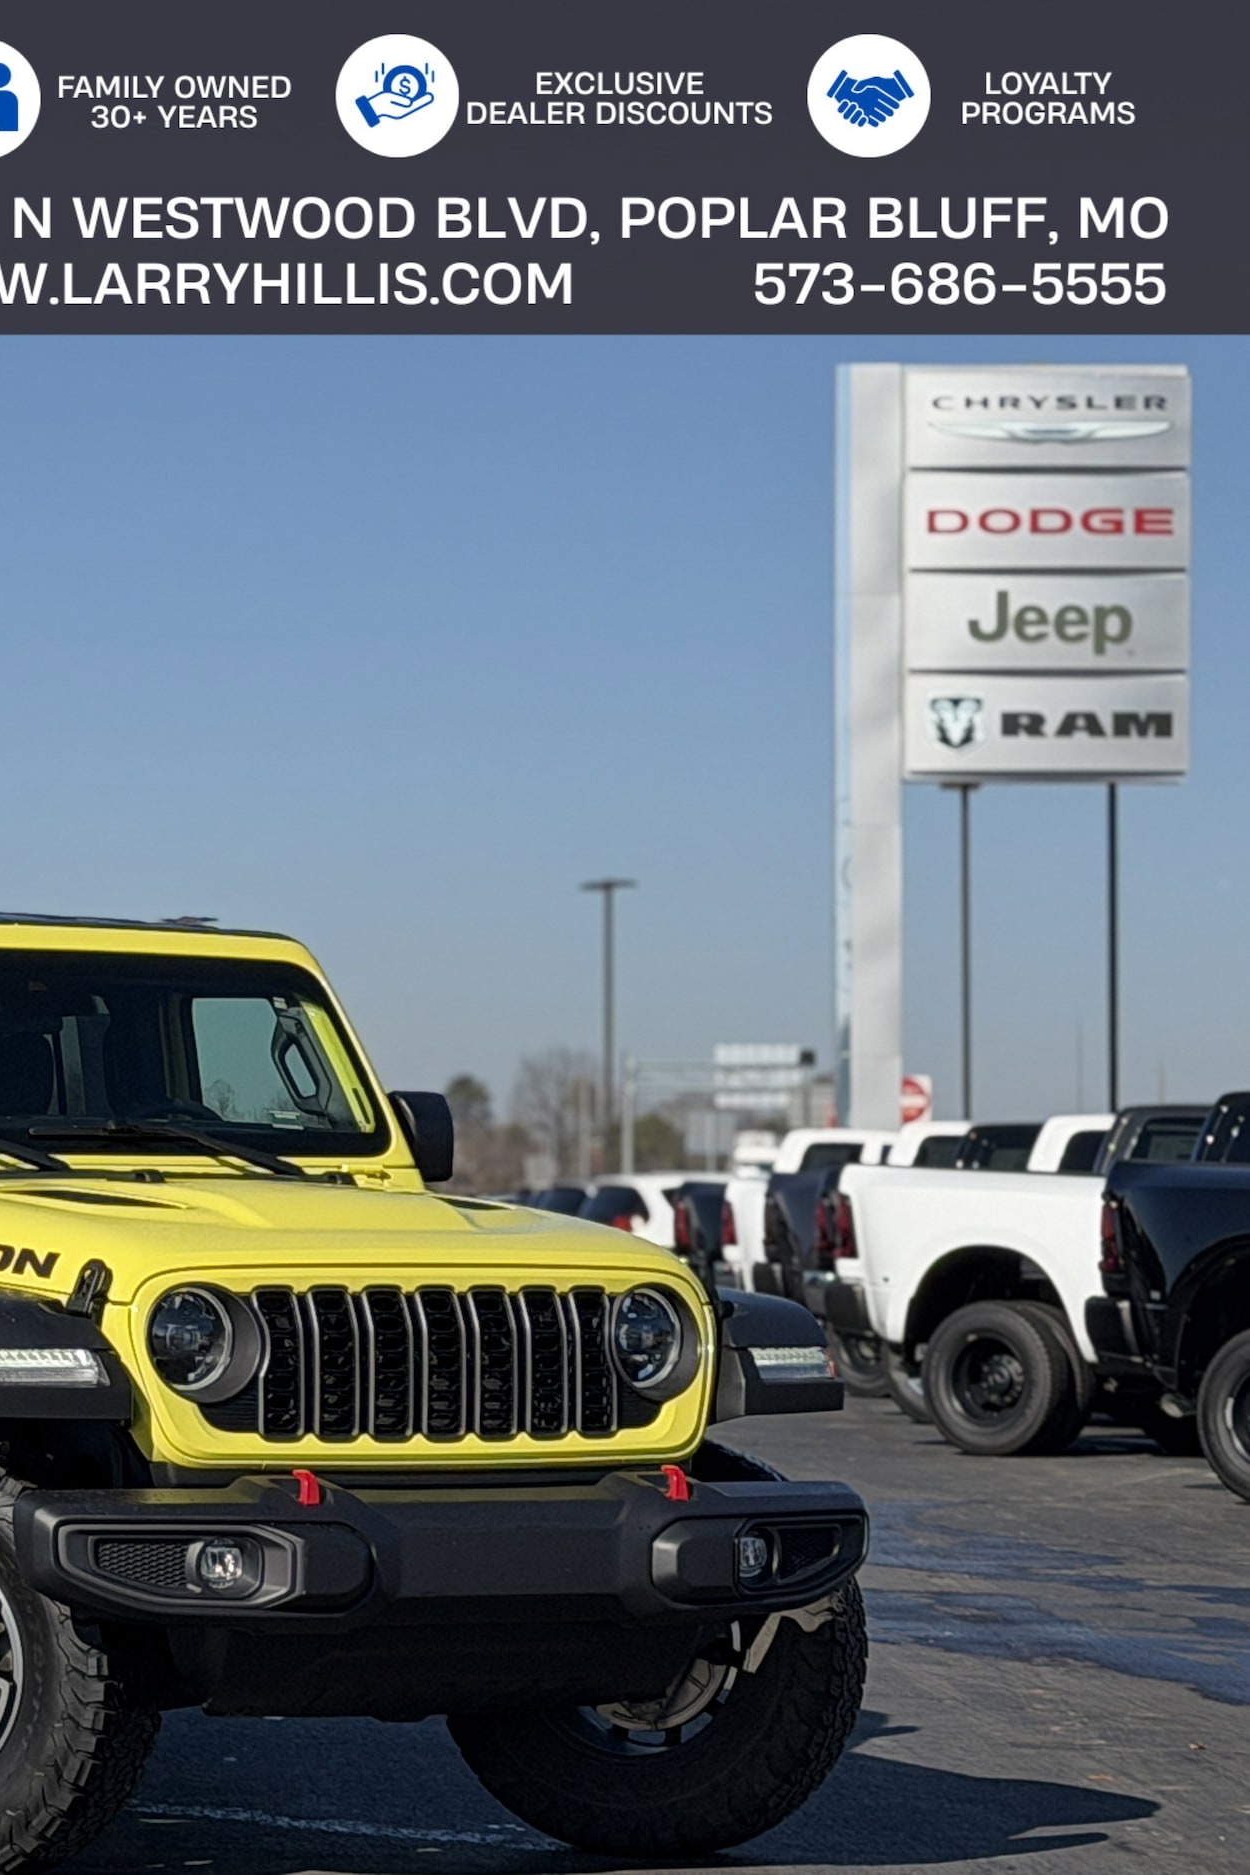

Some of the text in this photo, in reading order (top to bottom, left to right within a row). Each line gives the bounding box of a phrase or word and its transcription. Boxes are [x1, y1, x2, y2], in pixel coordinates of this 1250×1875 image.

[932, 394, 1168, 411] CHRYSLER
[927, 508, 1175, 536] DODGE
[968, 590, 1134, 656] Jeep
[1000, 711, 1174, 738] RAM
